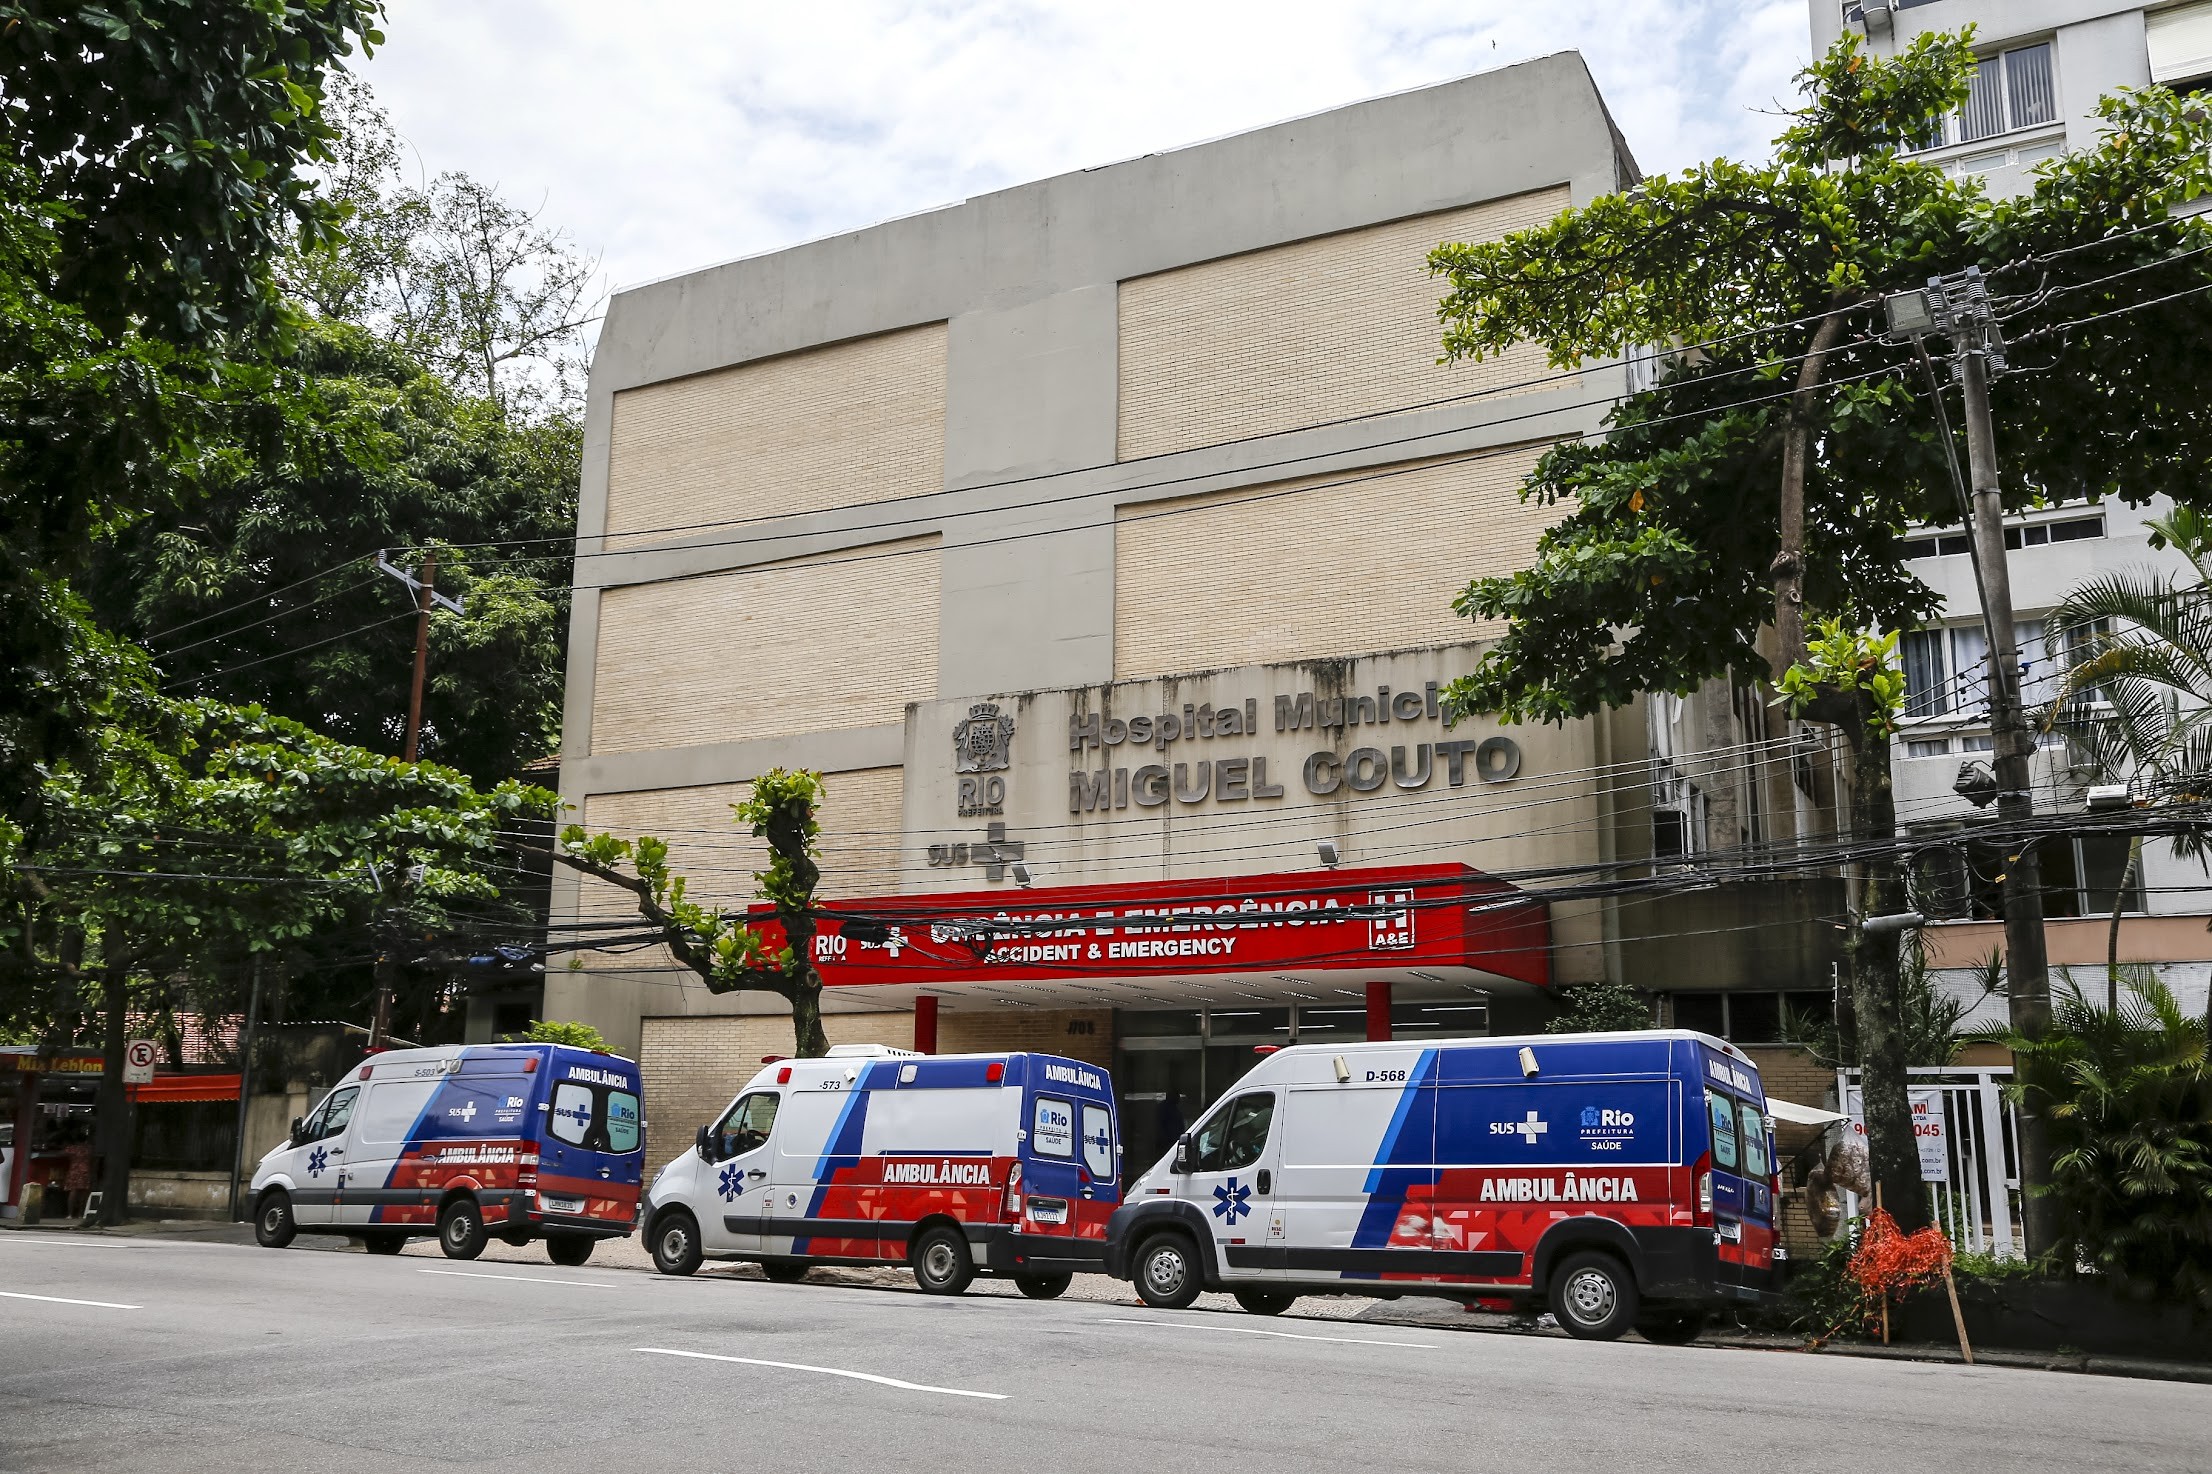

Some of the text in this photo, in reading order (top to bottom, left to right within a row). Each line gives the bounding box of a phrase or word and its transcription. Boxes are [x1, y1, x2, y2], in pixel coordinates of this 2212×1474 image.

[1069, 681, 1452, 750] Hospital Munici
[1069, 736, 1520, 812] MIGUEL COUTO
[957, 775, 1006, 807] RIO
[958, 807, 1004, 817] PREFEITURA
[928, 842, 969, 866] SUS
[815, 934, 847, 955] RIO
[1375, 931, 1409, 946] A&E
[983, 937, 1236, 964] ACCIDENT & EMERGENCY
[17, 1055, 103, 1071] Mix Leblon
[568, 1066, 628, 1089] AMBULÂNCIA
[1045, 1064, 1102, 1090] AMBULÂNCIA
[1366, 1070, 1406, 1081] D-568
[1709, 1059, 1752, 1095] AMBULÂNCIA
[448, 1108, 461, 1116] SUS
[507, 1096, 523, 1108] Rio
[620, 1107, 635, 1119] Rio
[1051, 1111, 1067, 1126] Rio
[1602, 1110, 1634, 1126] Rio
[1489, 1122, 1515, 1135] SUS
[438, 1143, 514, 1163] AMBULÂNCIA
[1591, 1140, 1622, 1150] SAÚDE
[883, 1159, 990, 1184] AMBULÂNCIA
[1480, 1171, 1639, 1202] AMBULÂNCIA
